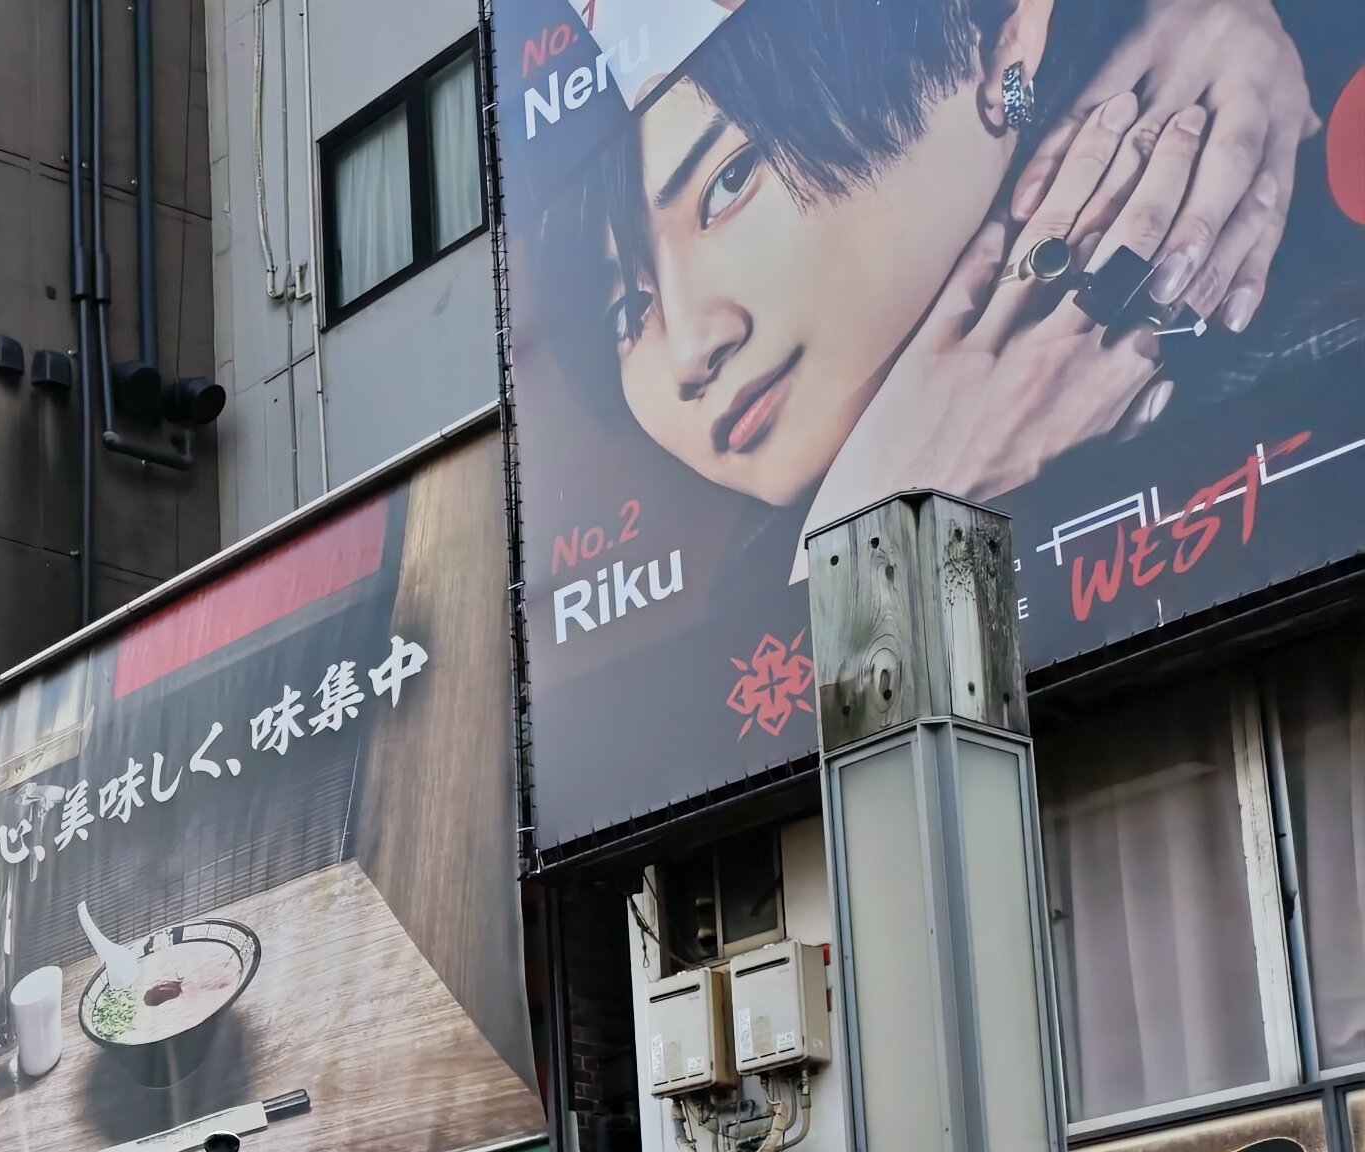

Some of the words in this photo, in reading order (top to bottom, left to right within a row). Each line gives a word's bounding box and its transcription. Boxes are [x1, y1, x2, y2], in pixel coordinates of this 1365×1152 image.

[524, 24, 651, 140] Neru
[549, 498, 641, 578] No.2
[1072, 431, 1312, 621] WEST
[553, 548, 684, 645] Riku
